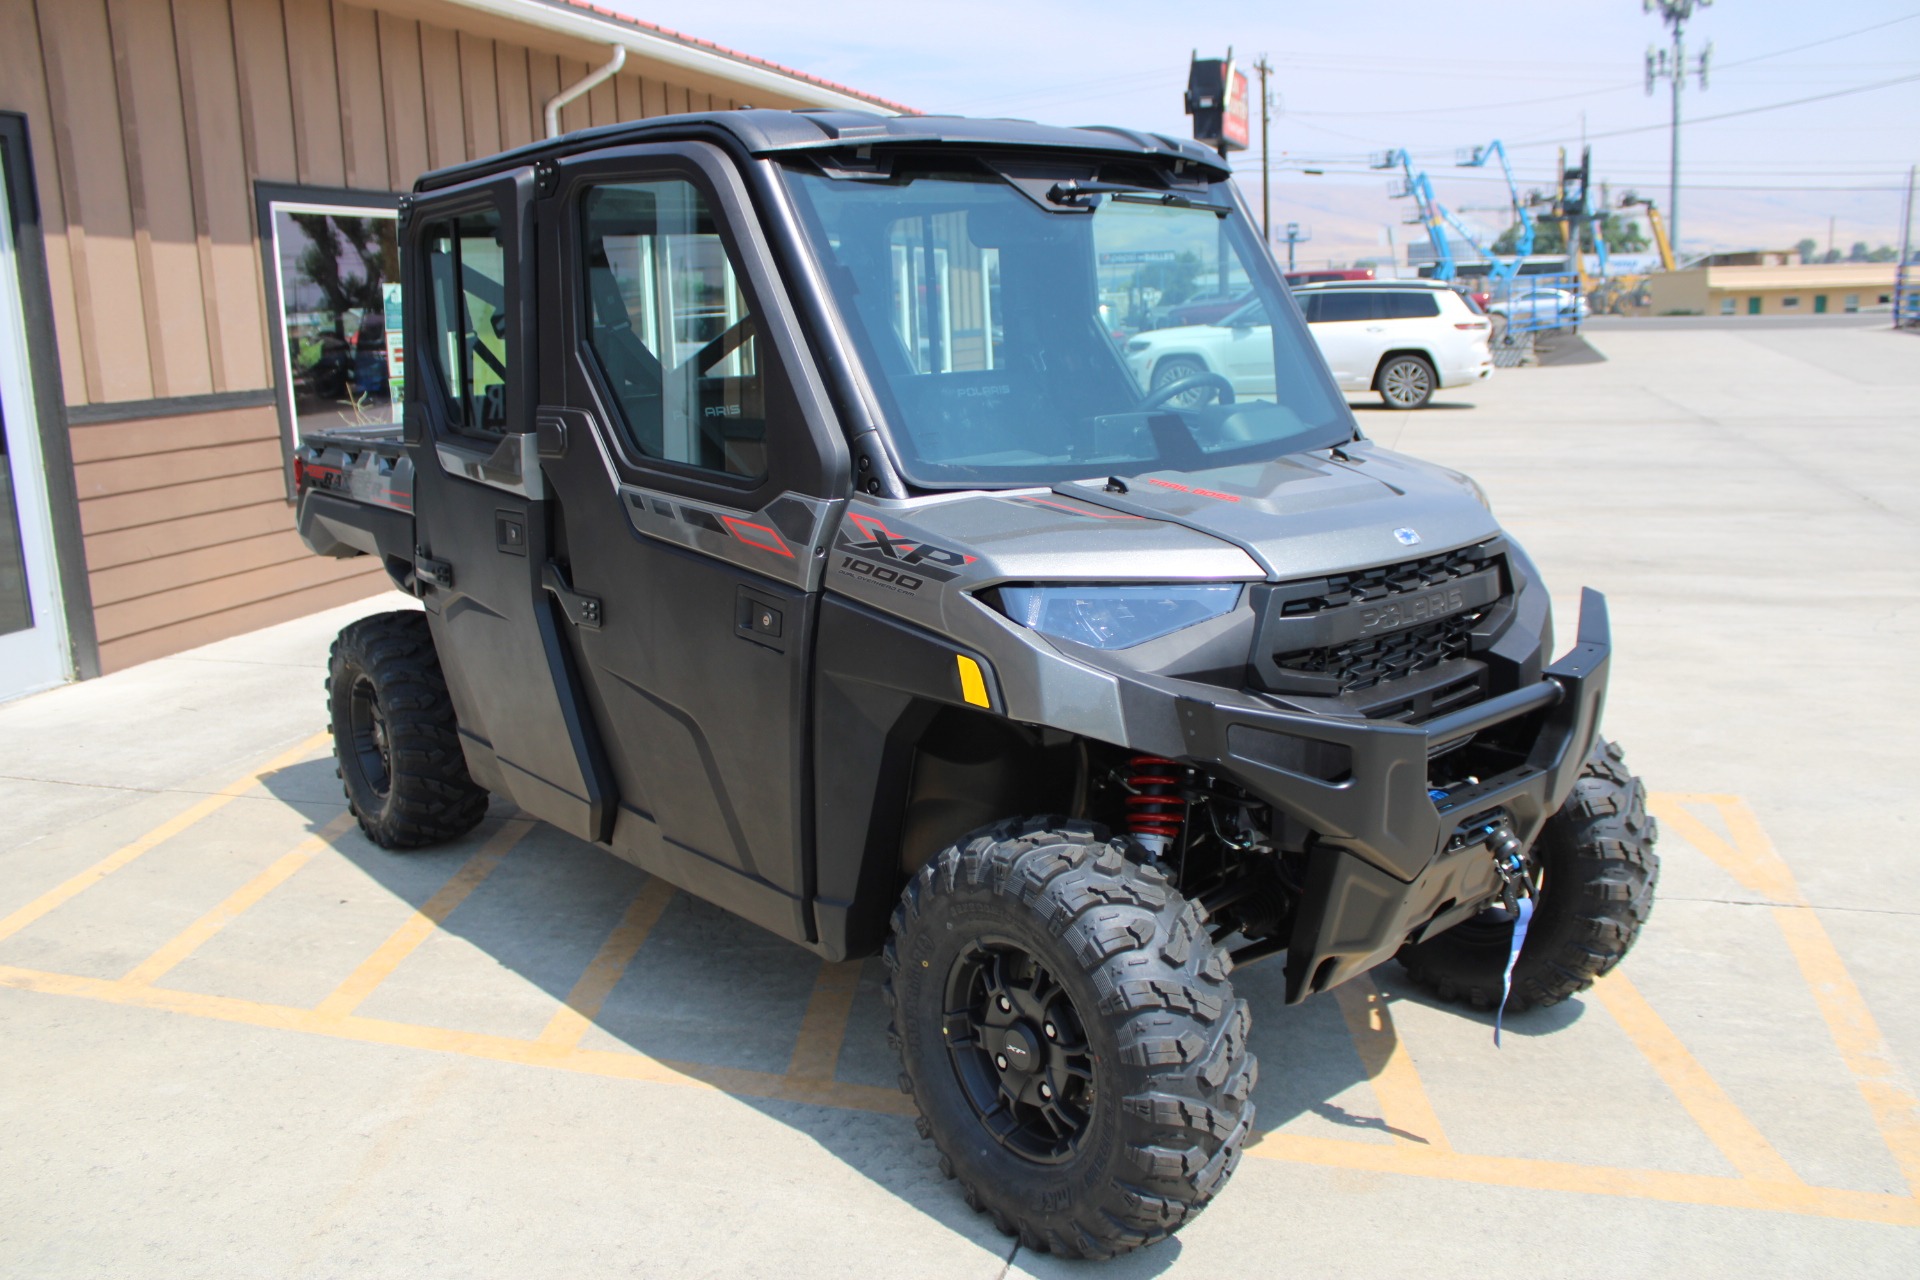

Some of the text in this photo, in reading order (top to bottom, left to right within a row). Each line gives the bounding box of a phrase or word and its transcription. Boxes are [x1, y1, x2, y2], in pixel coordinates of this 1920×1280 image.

[957, 384, 1010, 398] POLARIS
[1149, 478, 1242, 503] TRAIL BOSS
[844, 528, 965, 567] XP
[838, 569, 915, 597] DUAL OVERHEAD CAM
[841, 556, 924, 591] 1000
[1359, 590, 1463, 635] POLARIS
[1005, 1043, 1027, 1055] XP
